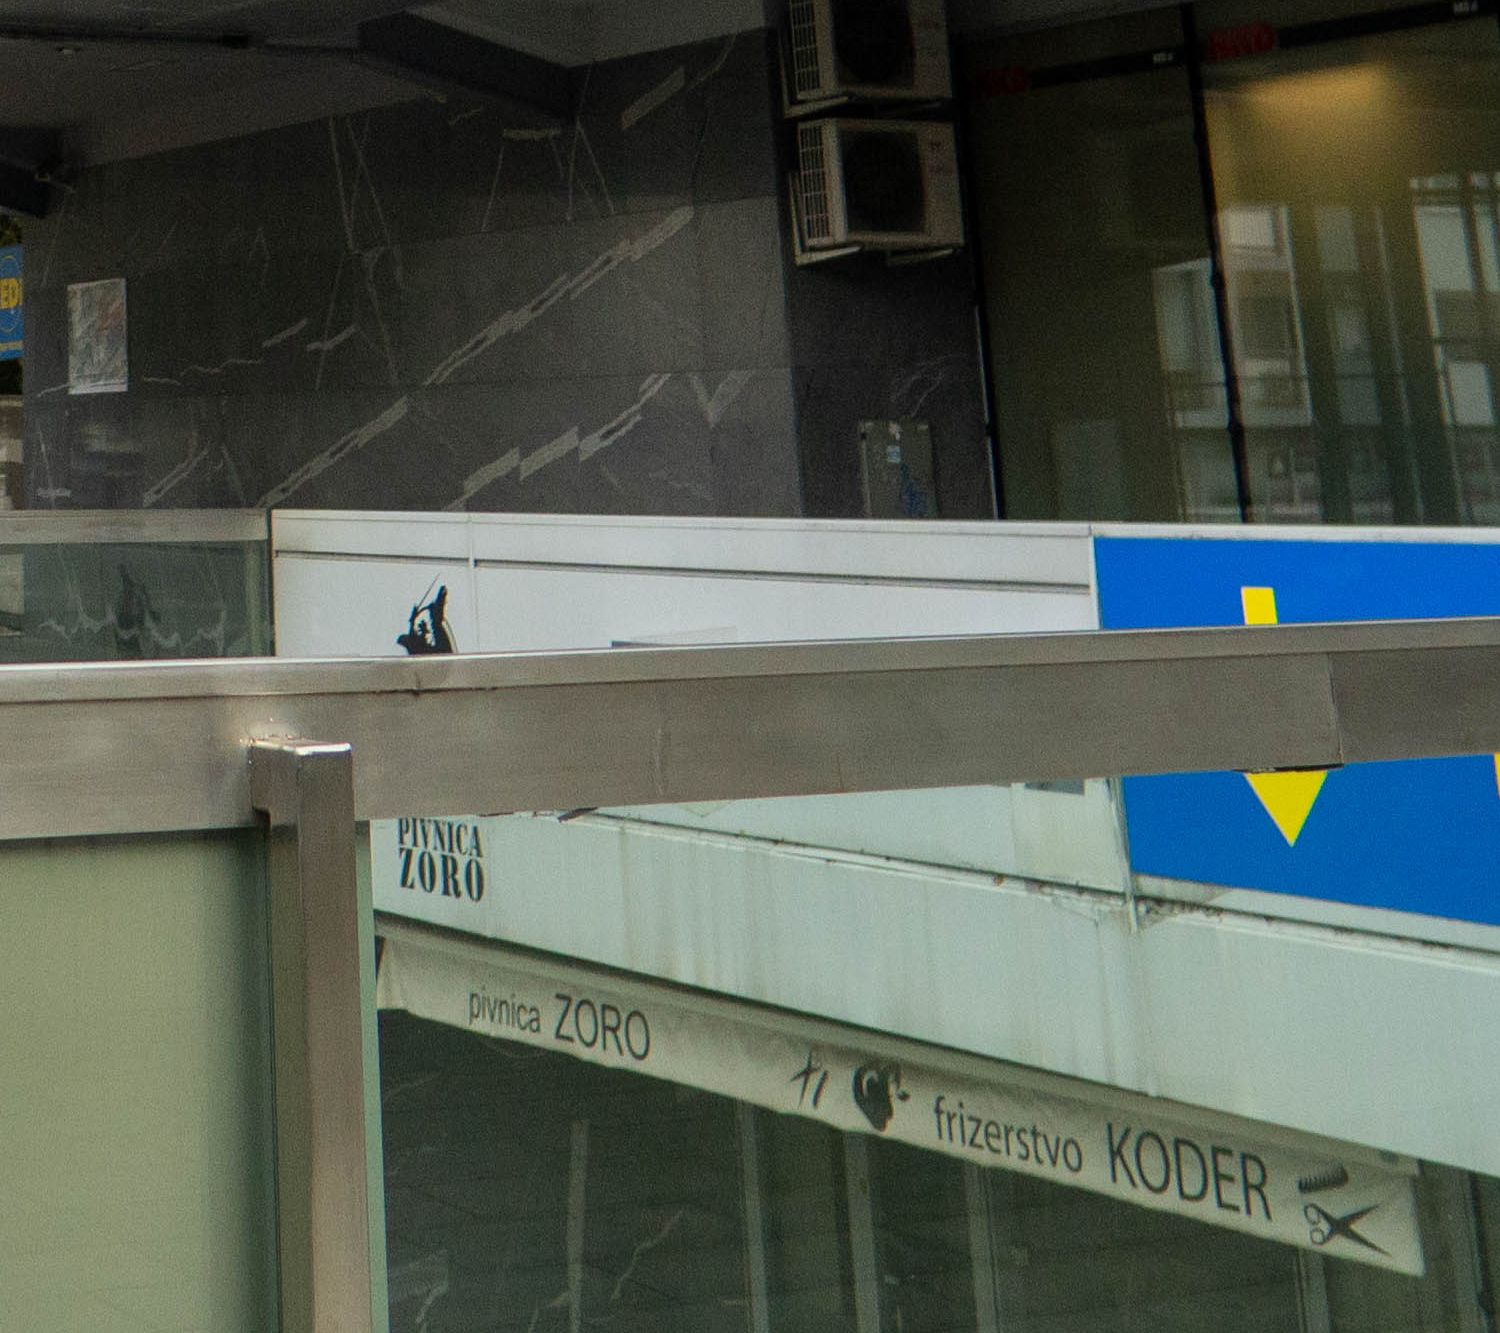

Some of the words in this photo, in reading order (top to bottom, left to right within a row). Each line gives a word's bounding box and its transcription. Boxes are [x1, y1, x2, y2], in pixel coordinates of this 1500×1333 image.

[398, 818, 484, 858] PIVNICA
[399, 847, 485, 902] ZORO
[469, 985, 541, 1033] pivnica
[553, 992, 650, 1060] ZORO
[934, 1095, 1083, 1173] frizerstvo
[1106, 1122, 1273, 1221] KODER
